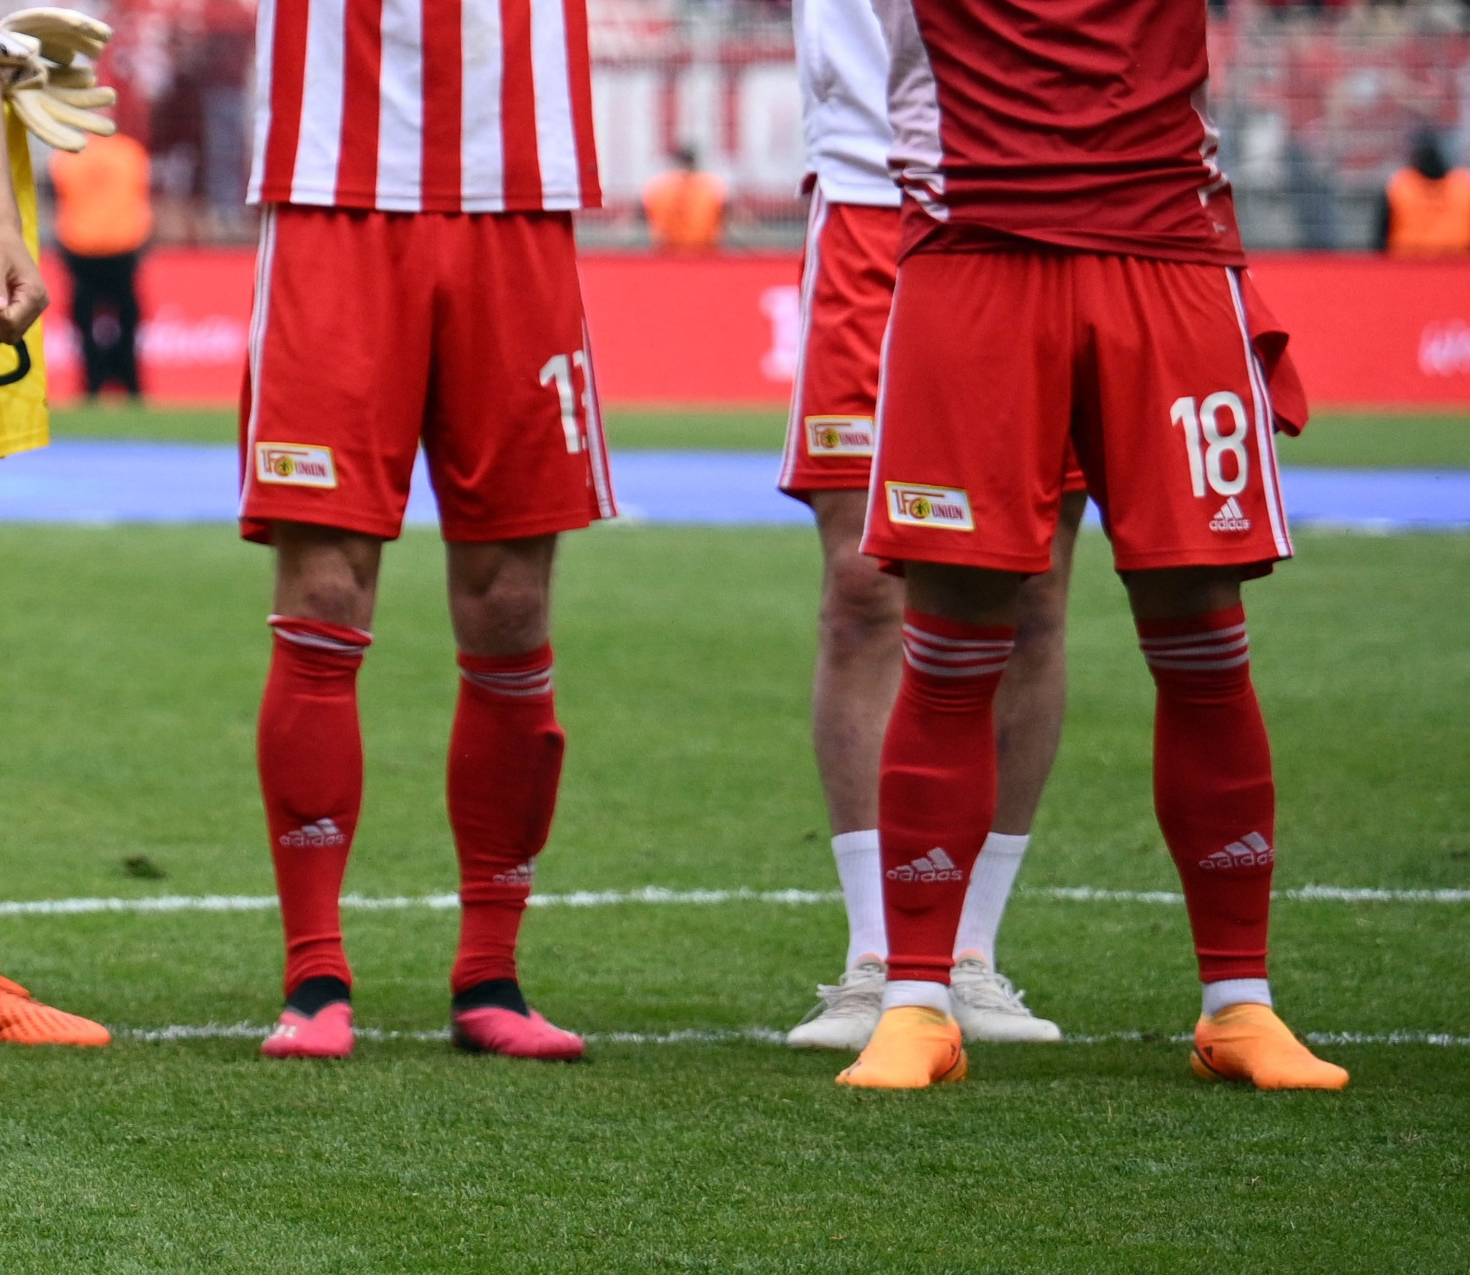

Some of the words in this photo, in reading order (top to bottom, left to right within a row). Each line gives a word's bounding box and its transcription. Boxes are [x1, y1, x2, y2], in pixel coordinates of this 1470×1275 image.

[1170, 391, 1247, 497] 18
[931, 505, 963, 520] UNION
[1209, 518, 1250, 531] adidas
[280, 833, 347, 846] adidas
[1199, 852, 1274, 869] adidas
[887, 870, 963, 882] adidas
